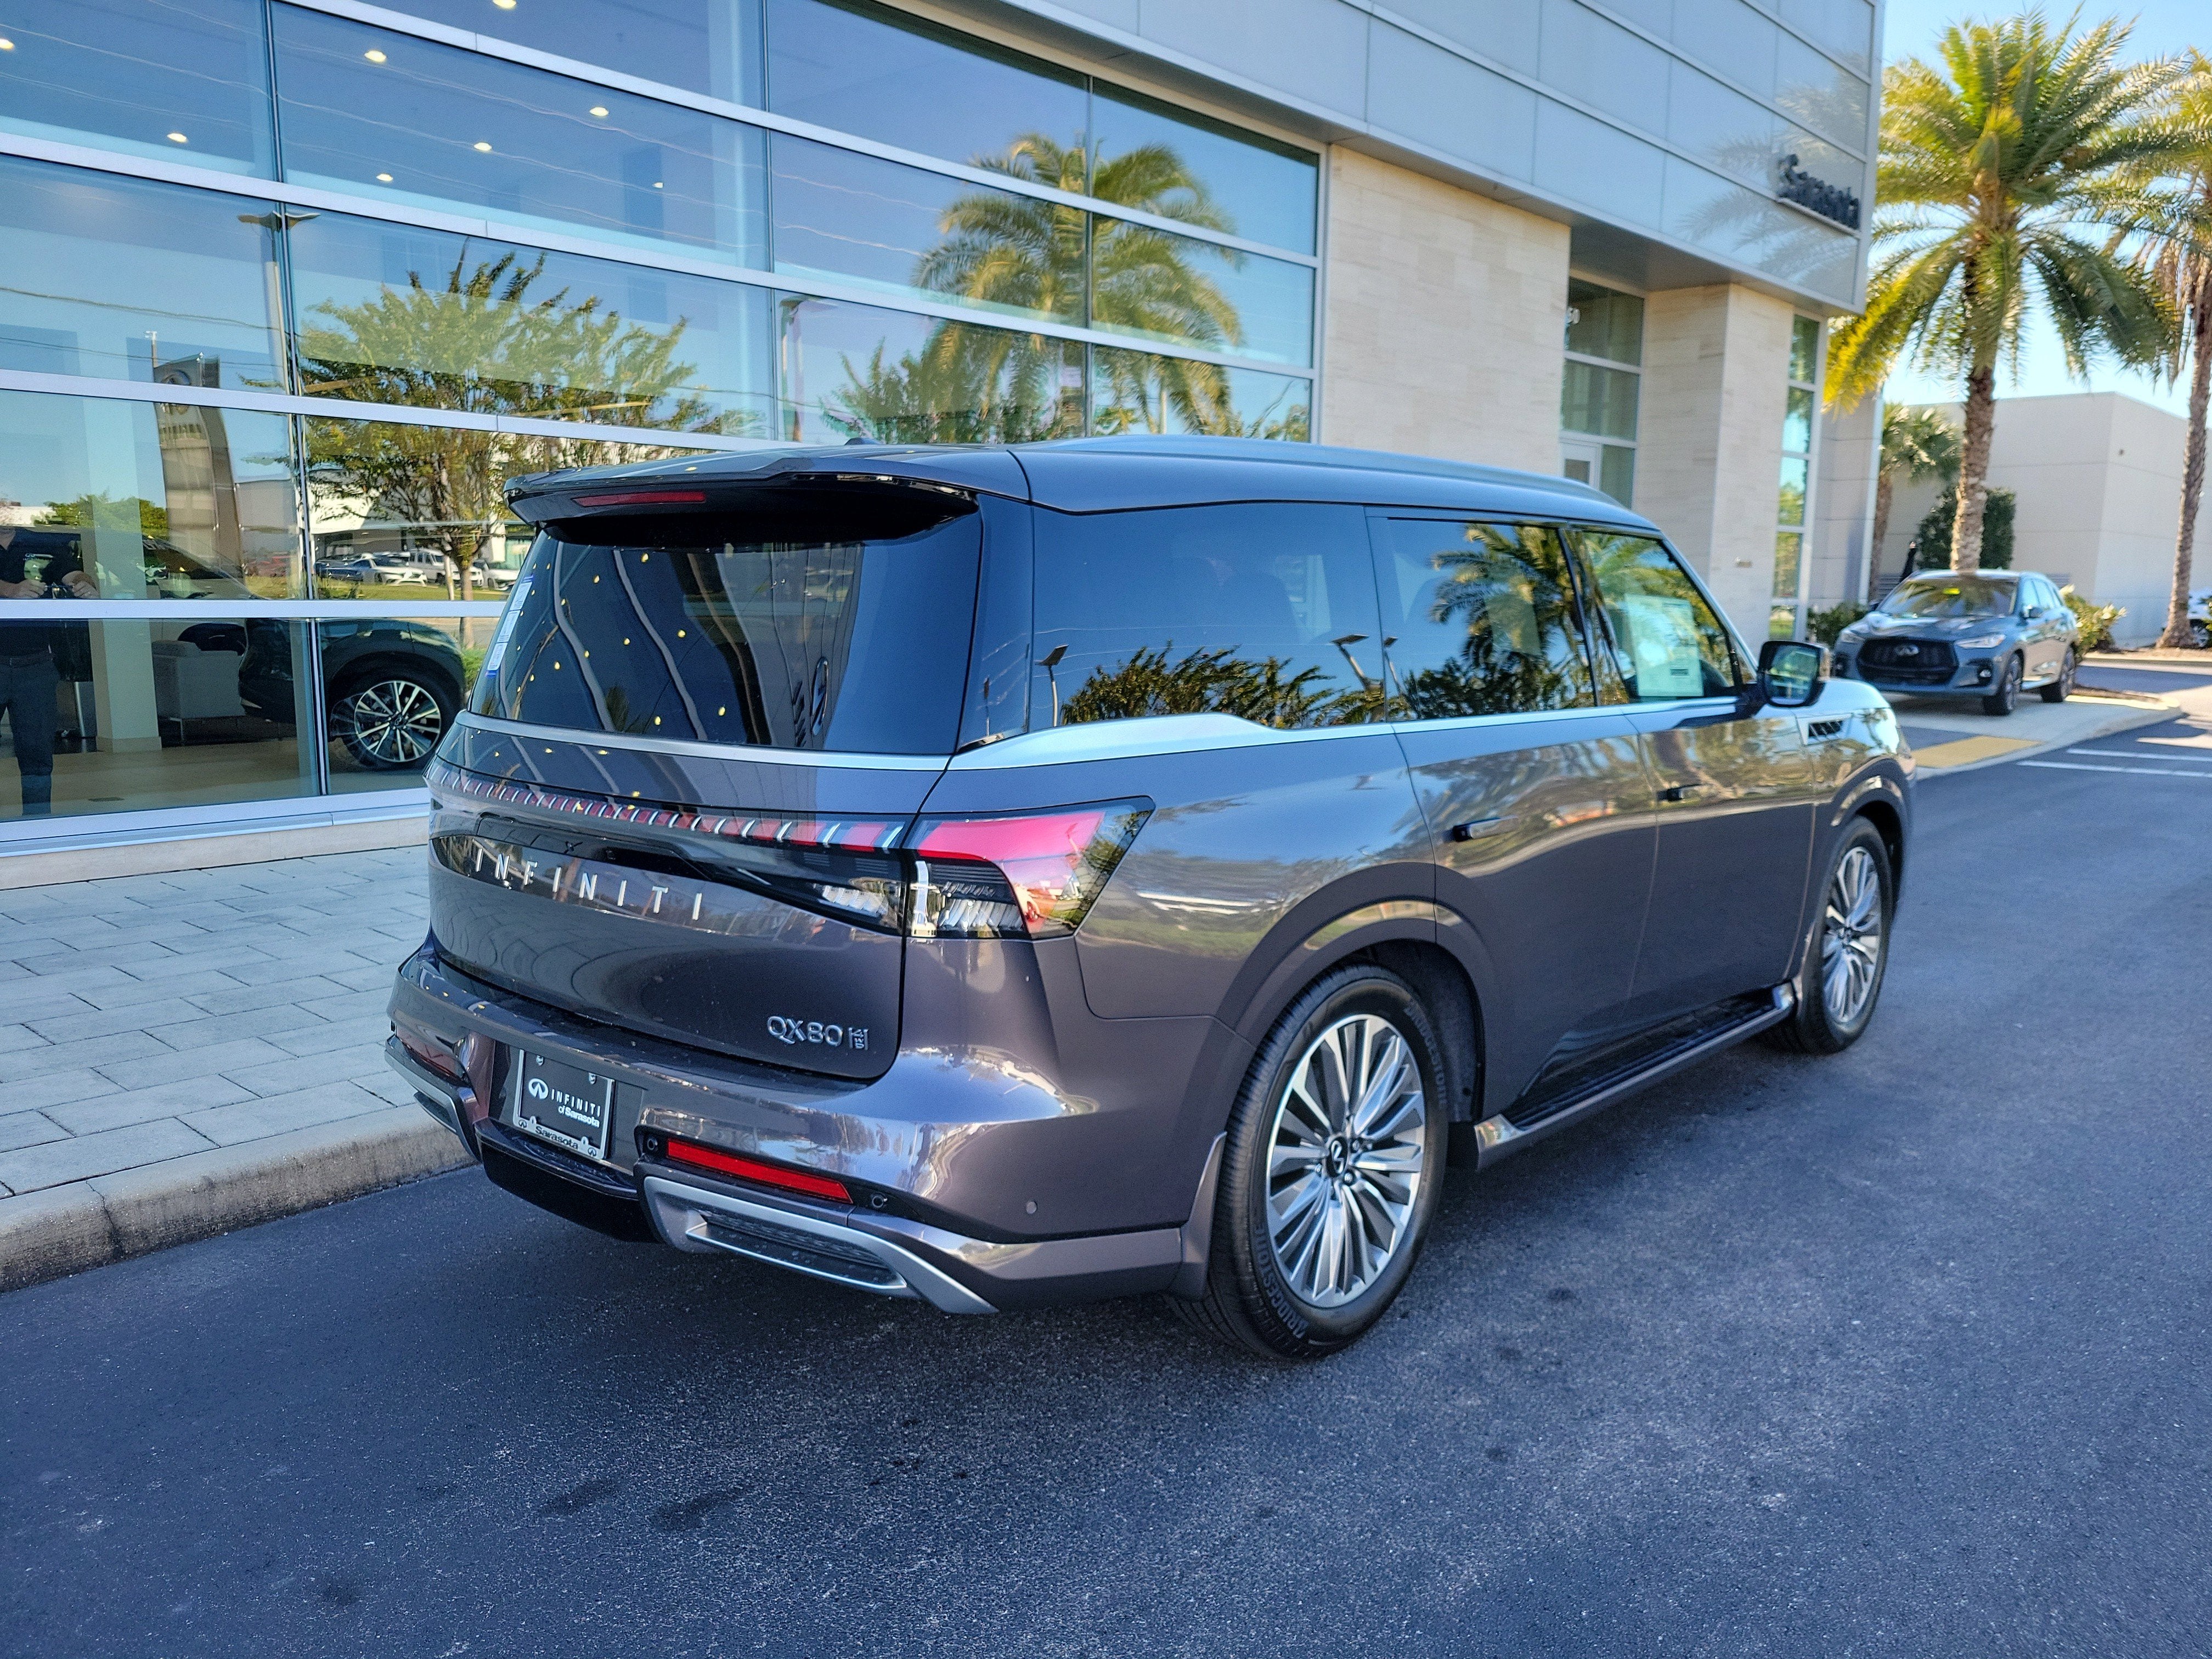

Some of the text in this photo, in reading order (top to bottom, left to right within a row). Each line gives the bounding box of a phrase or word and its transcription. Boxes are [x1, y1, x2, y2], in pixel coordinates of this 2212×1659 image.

[476, 848, 702, 920] INFINITI
[767, 1016, 843, 1046] QX80
[551, 1088, 601, 1117] INFINITI
[565, 1108, 600, 1128] Sarasota
[535, 1126, 579, 1149] Sarasota
